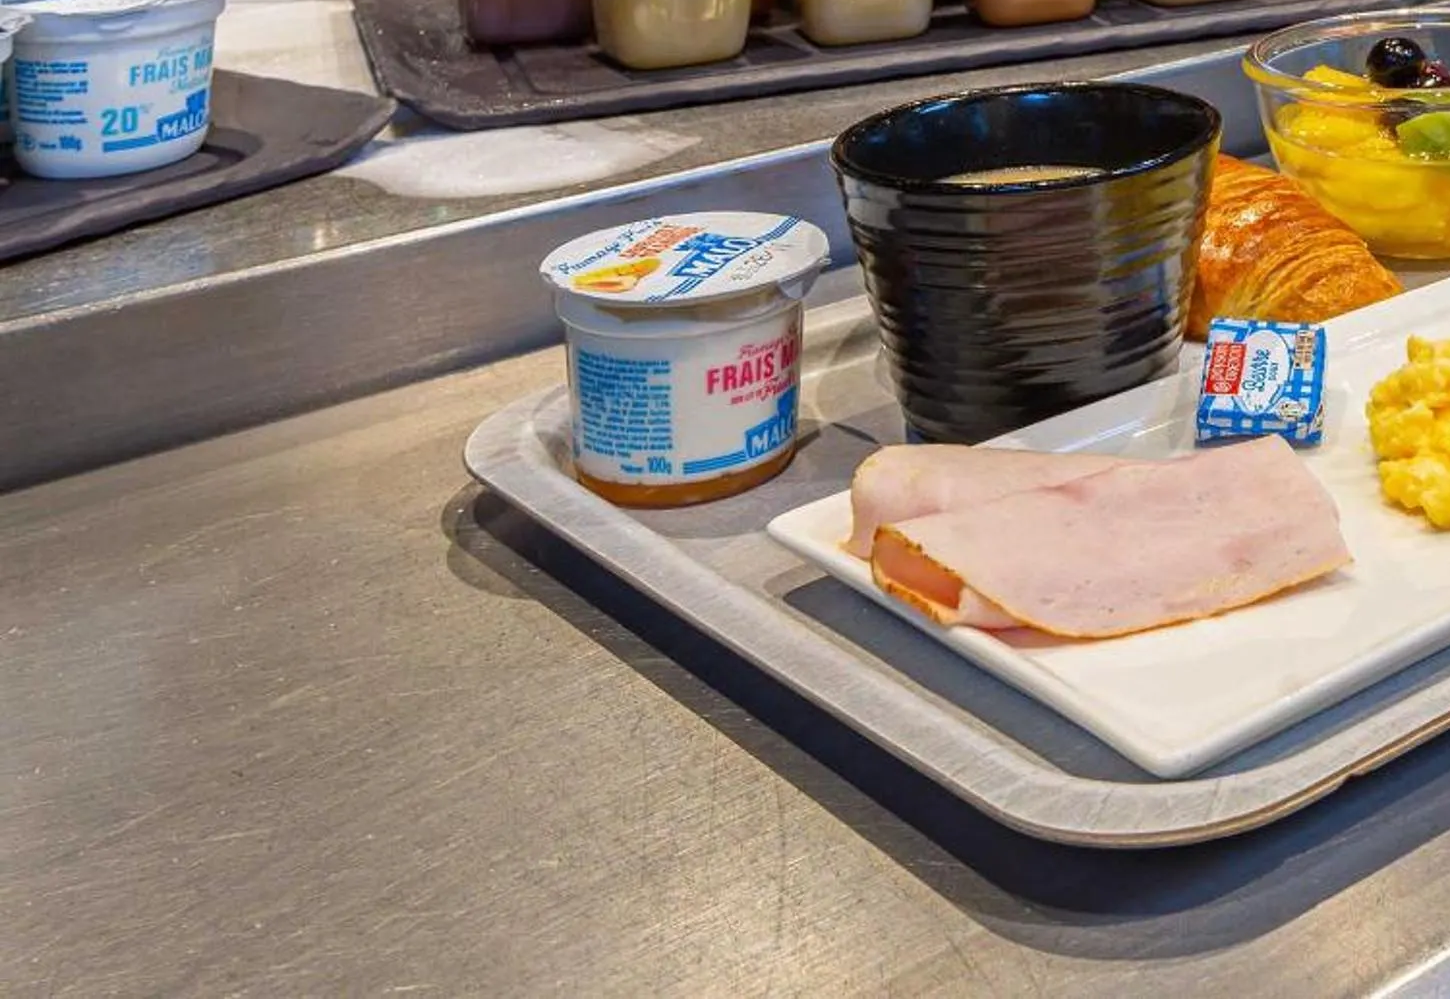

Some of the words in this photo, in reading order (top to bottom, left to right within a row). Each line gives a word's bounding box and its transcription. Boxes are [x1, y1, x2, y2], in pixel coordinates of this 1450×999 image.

[129, 55, 188, 86] FRAIS
[101, 107, 138, 136] 20
[678, 236, 749, 279] MALO
[706, 352, 774, 395] FRAIS
